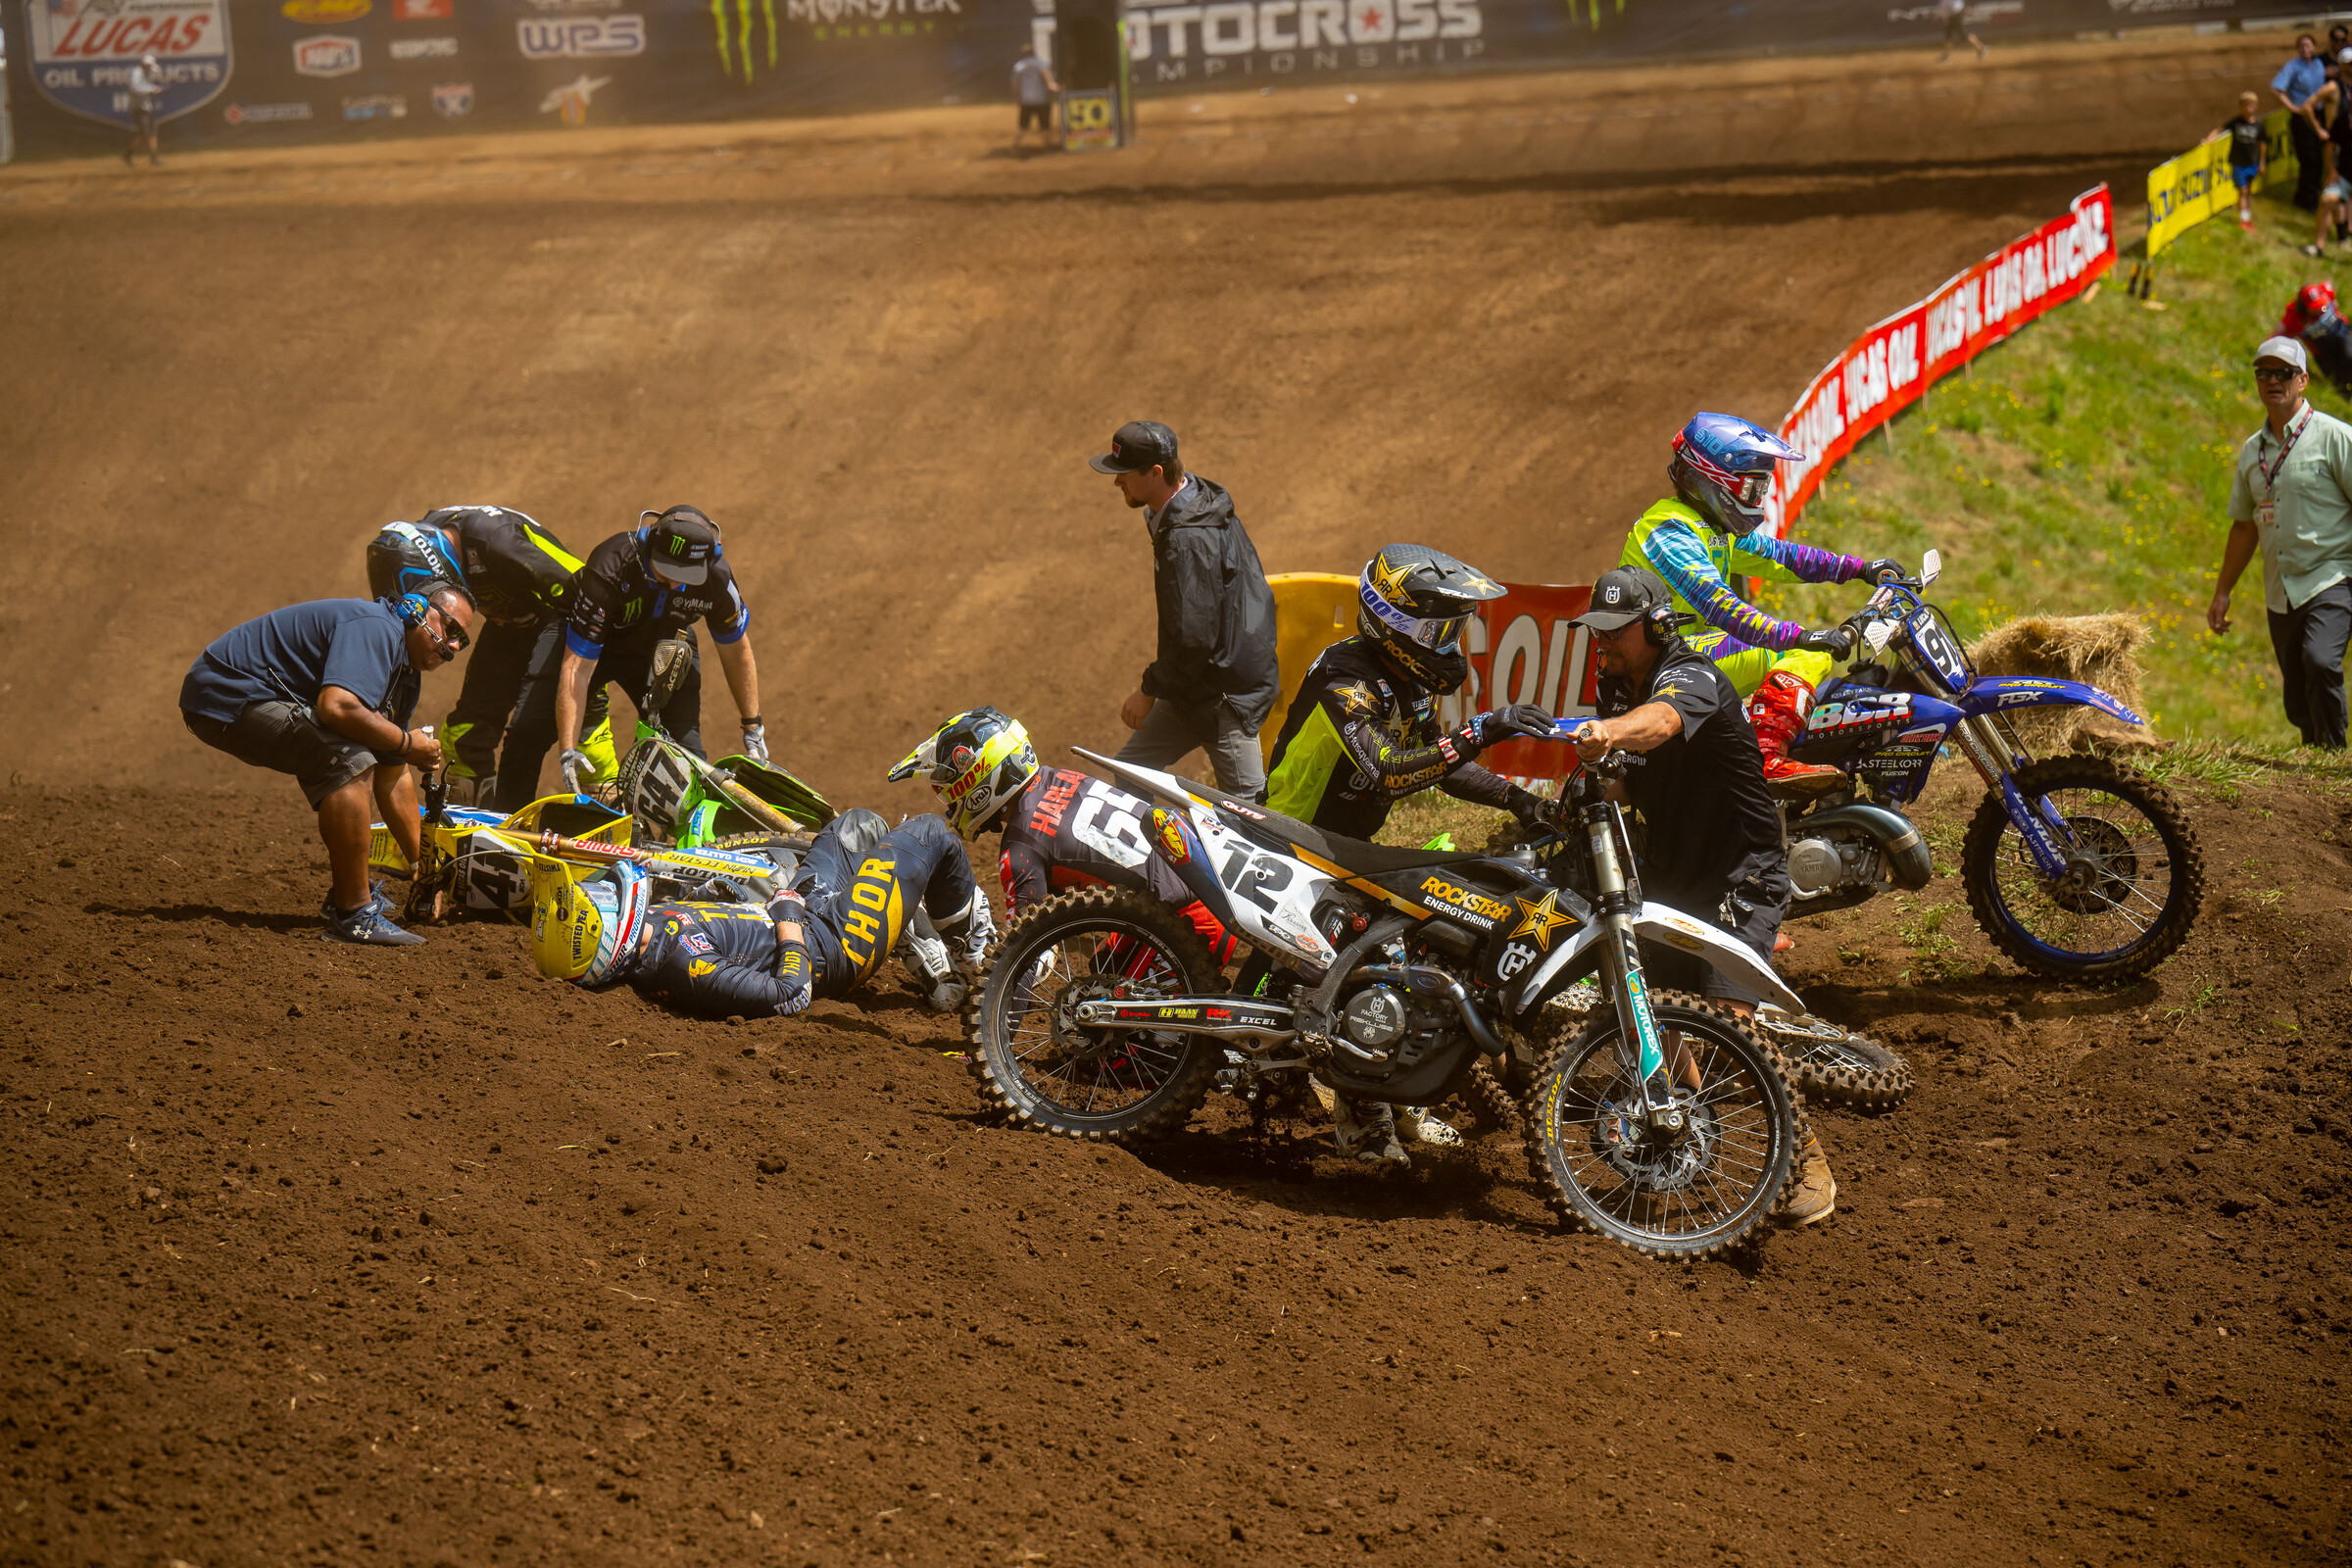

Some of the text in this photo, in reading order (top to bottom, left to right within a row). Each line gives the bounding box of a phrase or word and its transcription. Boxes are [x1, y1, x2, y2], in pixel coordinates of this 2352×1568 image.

[53, 15, 211, 57] LUCAS
[524, 21, 641, 53] WPS
[45, 70, 84, 88] OIL
[668, 647, 685, 692] ACERBIS
[1492, 613, 1598, 717] OIL
[1808, 717, 1911, 741] MOTORSPORTS
[1901, 733, 1943, 743] DIRT BIKE
[1348, 732, 1380, 779] Husqvarna
[1868, 759, 1923, 769] STEELKORR
[638, 747, 690, 828] 647
[946, 756, 993, 802] 100%
[1385, 760, 1448, 790] ROCKSTAR
[968, 788, 989, 808] Arai
[1221, 800, 1267, 821] GUTS
[715, 837, 769, 850] DUNLOP
[2013, 791, 2067, 866] DUNLOP
[575, 840, 636, 856] SHOWA
[668, 854, 721, 870] ECSTAR
[468, 845, 519, 908] 41
[1220, 839, 1294, 915] 12
[628, 885, 647, 944] PROGRESSIVE
[842, 858, 896, 967] THOR
[1420, 876, 1512, 923] ROCKSTAR
[1423, 896, 1495, 931] ENERGY DRINK
[572, 909, 589, 960] TWISTED TEA
[608, 943, 628, 976] THOR
[1206, 1007, 1232, 1018] RK
[1241, 1015, 1278, 1026] EXCEL
[1360, 1008, 1389, 1021] FACTORY
[1633, 994, 1660, 1055] MOTOREX
[1546, 1072, 1562, 1140] DUNLOP
